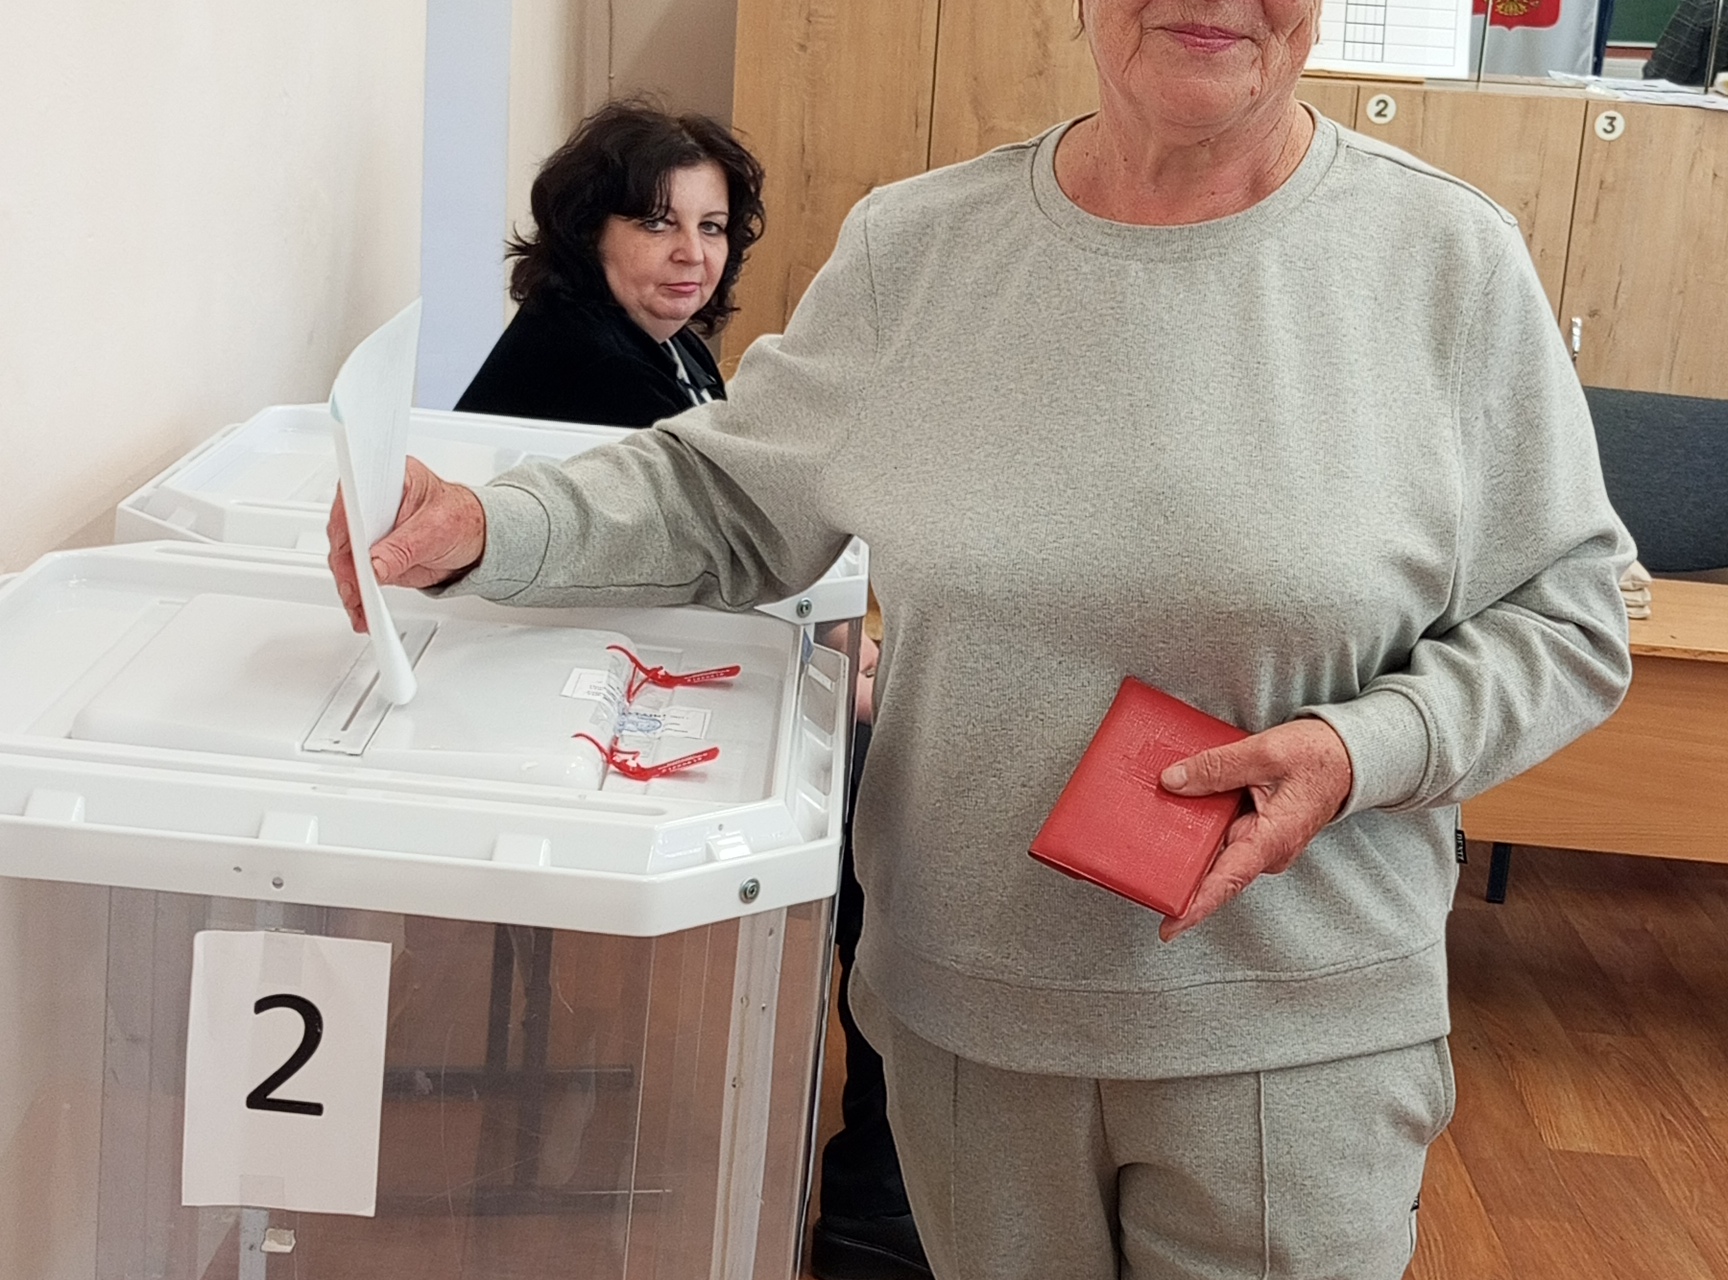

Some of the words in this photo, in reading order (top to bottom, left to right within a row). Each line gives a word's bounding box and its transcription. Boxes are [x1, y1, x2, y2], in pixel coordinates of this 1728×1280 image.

[1374, 99, 1389, 118] 2
[1602, 116, 1617, 135] 3
[246, 993, 324, 1116] 2
